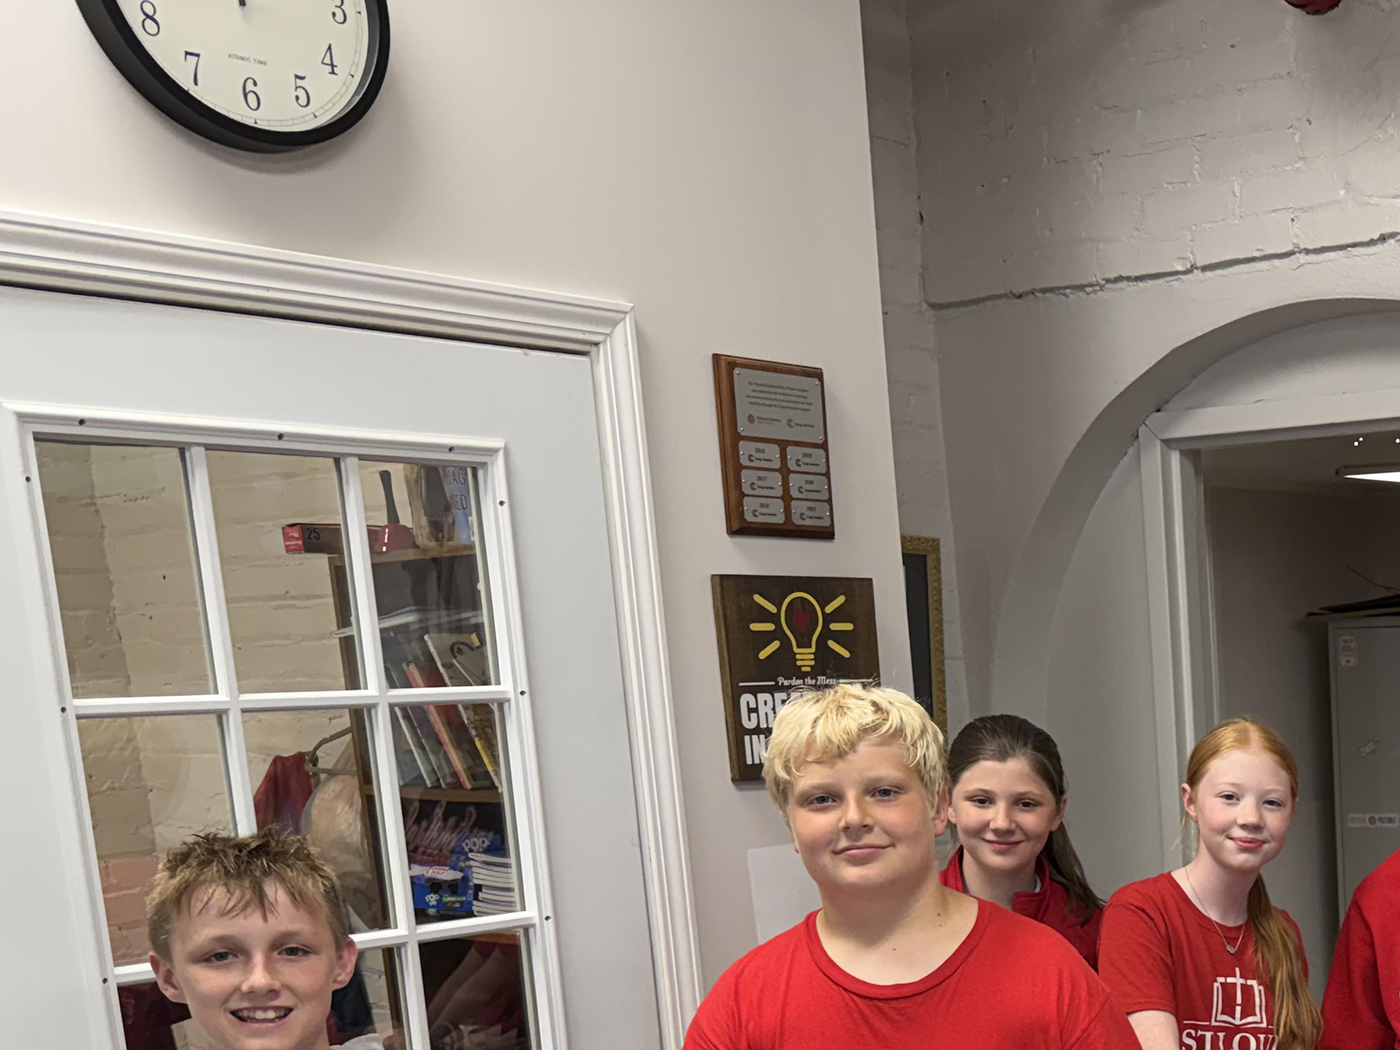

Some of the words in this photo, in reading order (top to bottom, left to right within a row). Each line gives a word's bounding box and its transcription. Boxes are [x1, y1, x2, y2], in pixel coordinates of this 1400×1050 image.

[140, 0, 160, 37] 8
[331, 0, 348, 25] 3
[184, 50, 201, 87] 7
[320, 43, 338, 76] 4
[242, 77, 261, 111] 6
[294, 73, 311, 108] 5
[777, 675, 804, 686] Pardon
[804, 675, 816, 685] the
